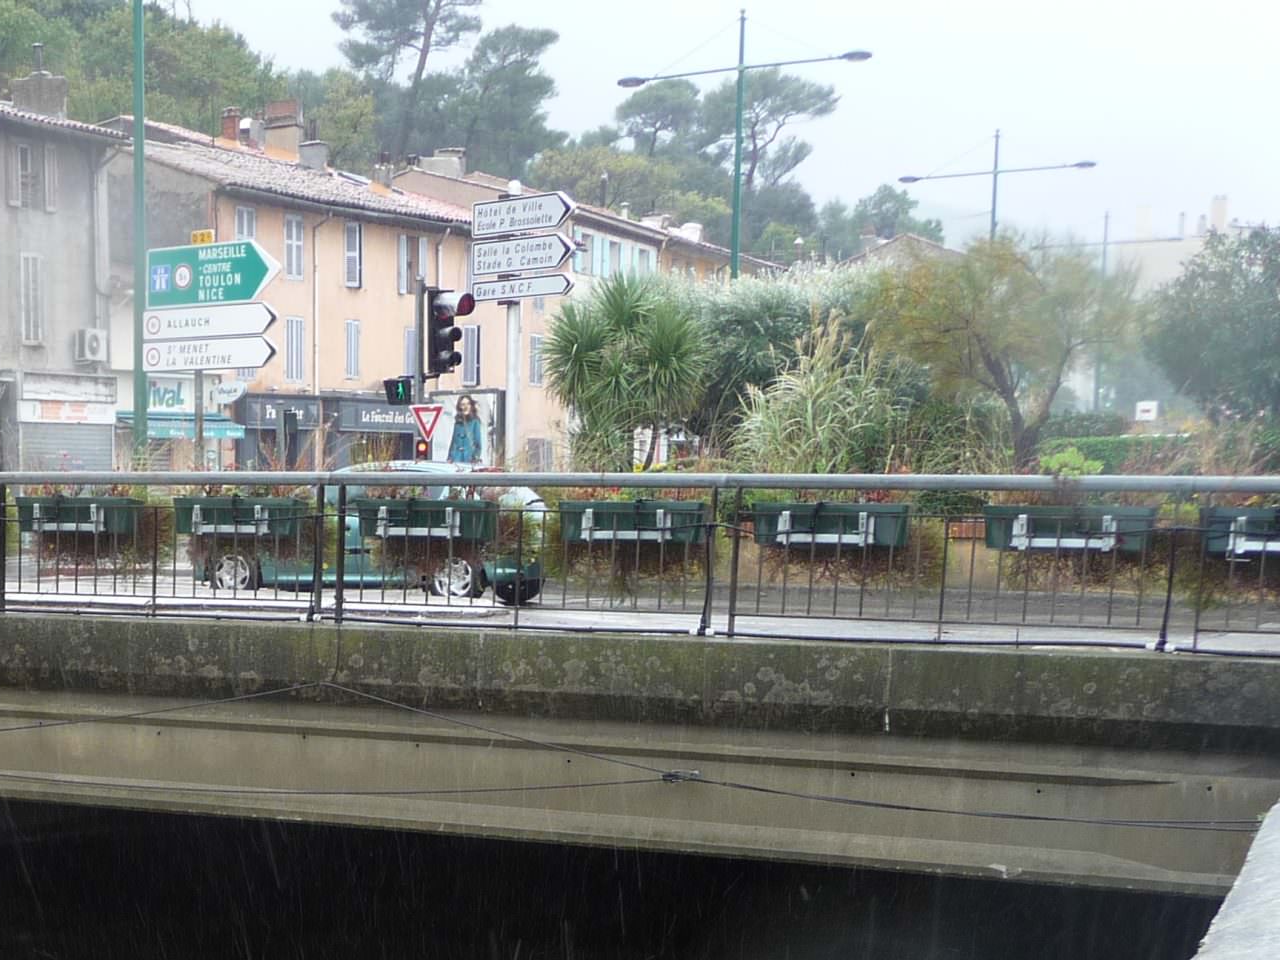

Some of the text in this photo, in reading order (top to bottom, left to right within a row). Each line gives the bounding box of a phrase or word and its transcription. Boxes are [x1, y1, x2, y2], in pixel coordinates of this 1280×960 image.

[506, 205, 517, 215] de
[523, 201, 543, 212] Ville
[198, 245, 247, 259] MARSEILLE
[477, 247, 498, 258] Salle
[515, 242, 553, 254] Colombe
[477, 259, 502, 270] Stade
[199, 273, 241, 287] TOULON
[198, 288, 224, 301] NICE
[477, 286, 496, 297] Gare
[167, 317, 210, 329] ALLAUCH
[166, 357, 177, 367] LA
[184, 355, 232, 367] VALENTINE
